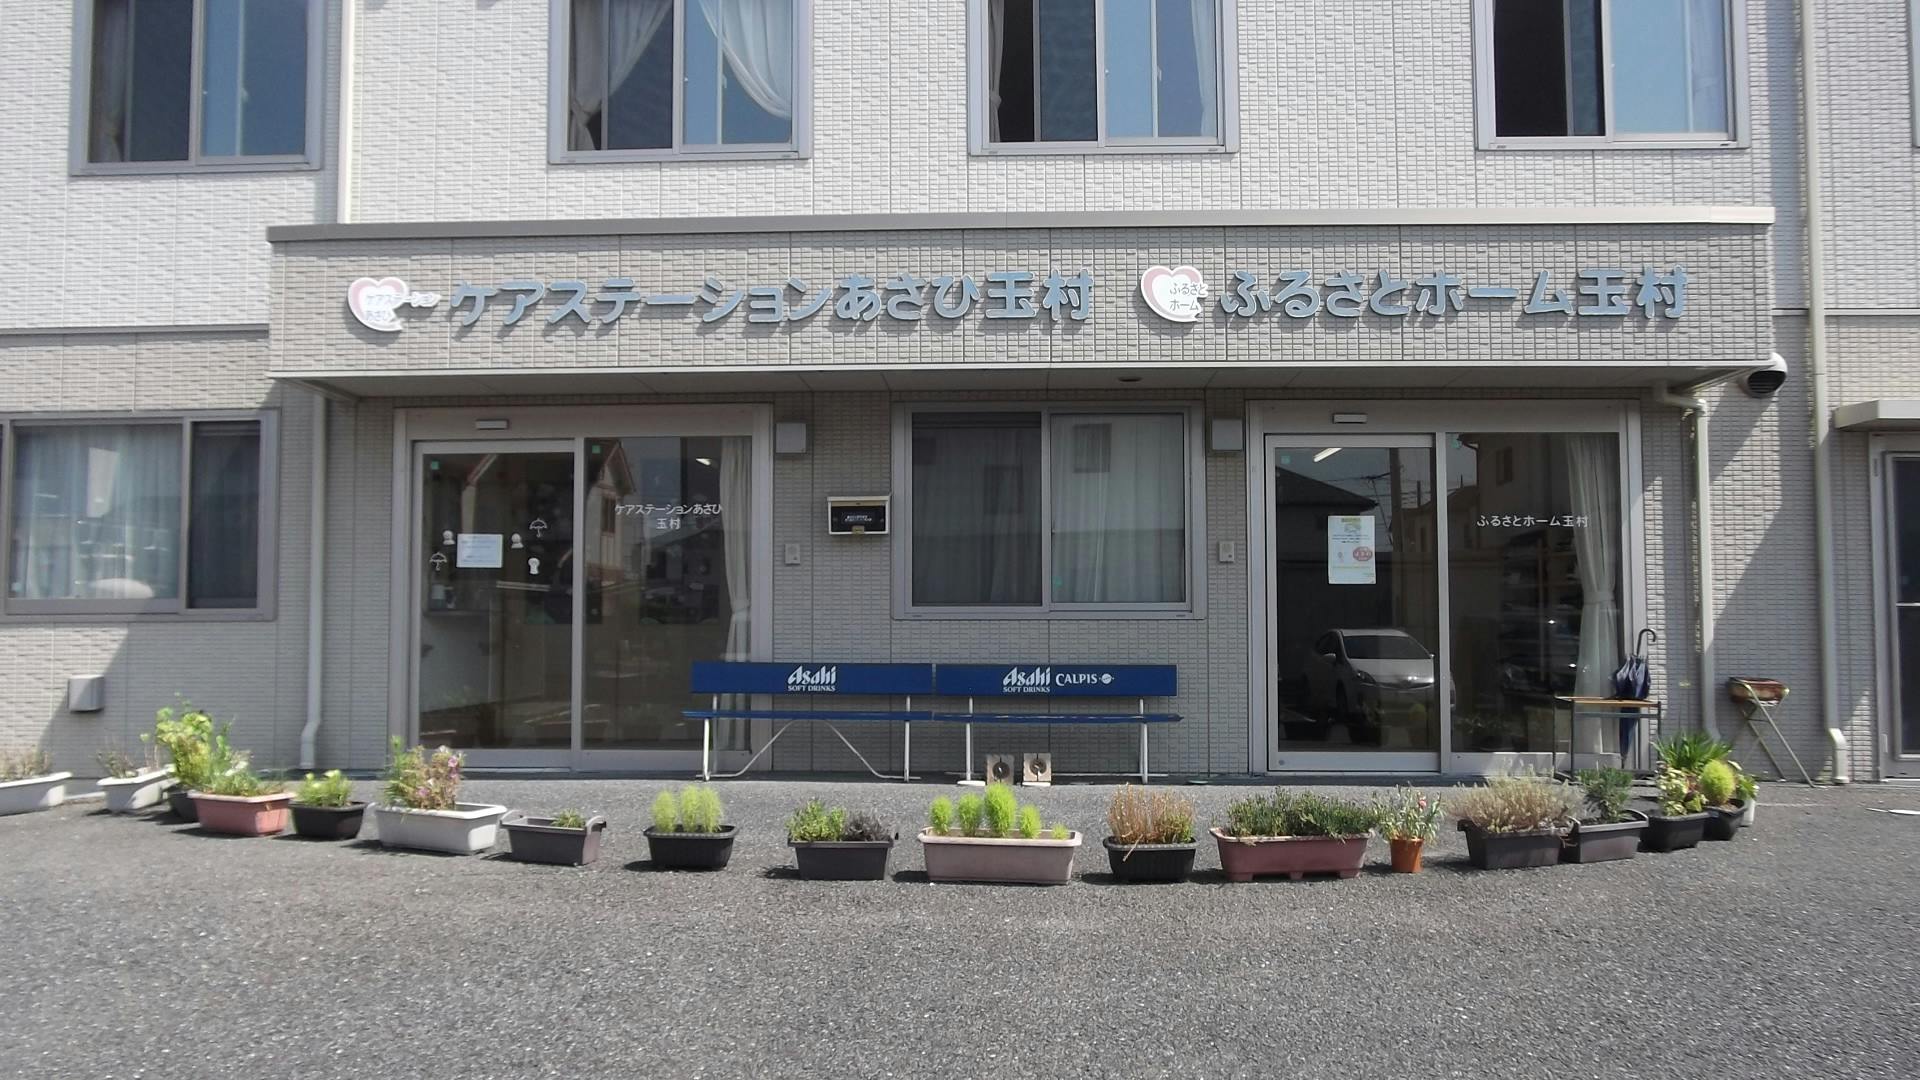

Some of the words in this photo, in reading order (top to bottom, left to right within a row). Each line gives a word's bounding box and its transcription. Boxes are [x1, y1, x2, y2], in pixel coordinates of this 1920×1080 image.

[1169, 283, 1208, 296] ふるさと
[1220, 264, 1688, 318] ふるさとホーム玉村
[451, 268, 1093, 325] ケアステーションあさひ玉村
[1169, 299, 1199, 311] ホーム
[614, 503, 723, 516] ケアステーションあさひ
[656, 517, 681, 530] 玉村
[1476, 515, 1589, 528] ふるさとホーム玉村
[787, 665, 837, 685] Asahi
[1002, 666, 1051, 686] Asahi
[1055, 673, 1098, 687] CALPIS
